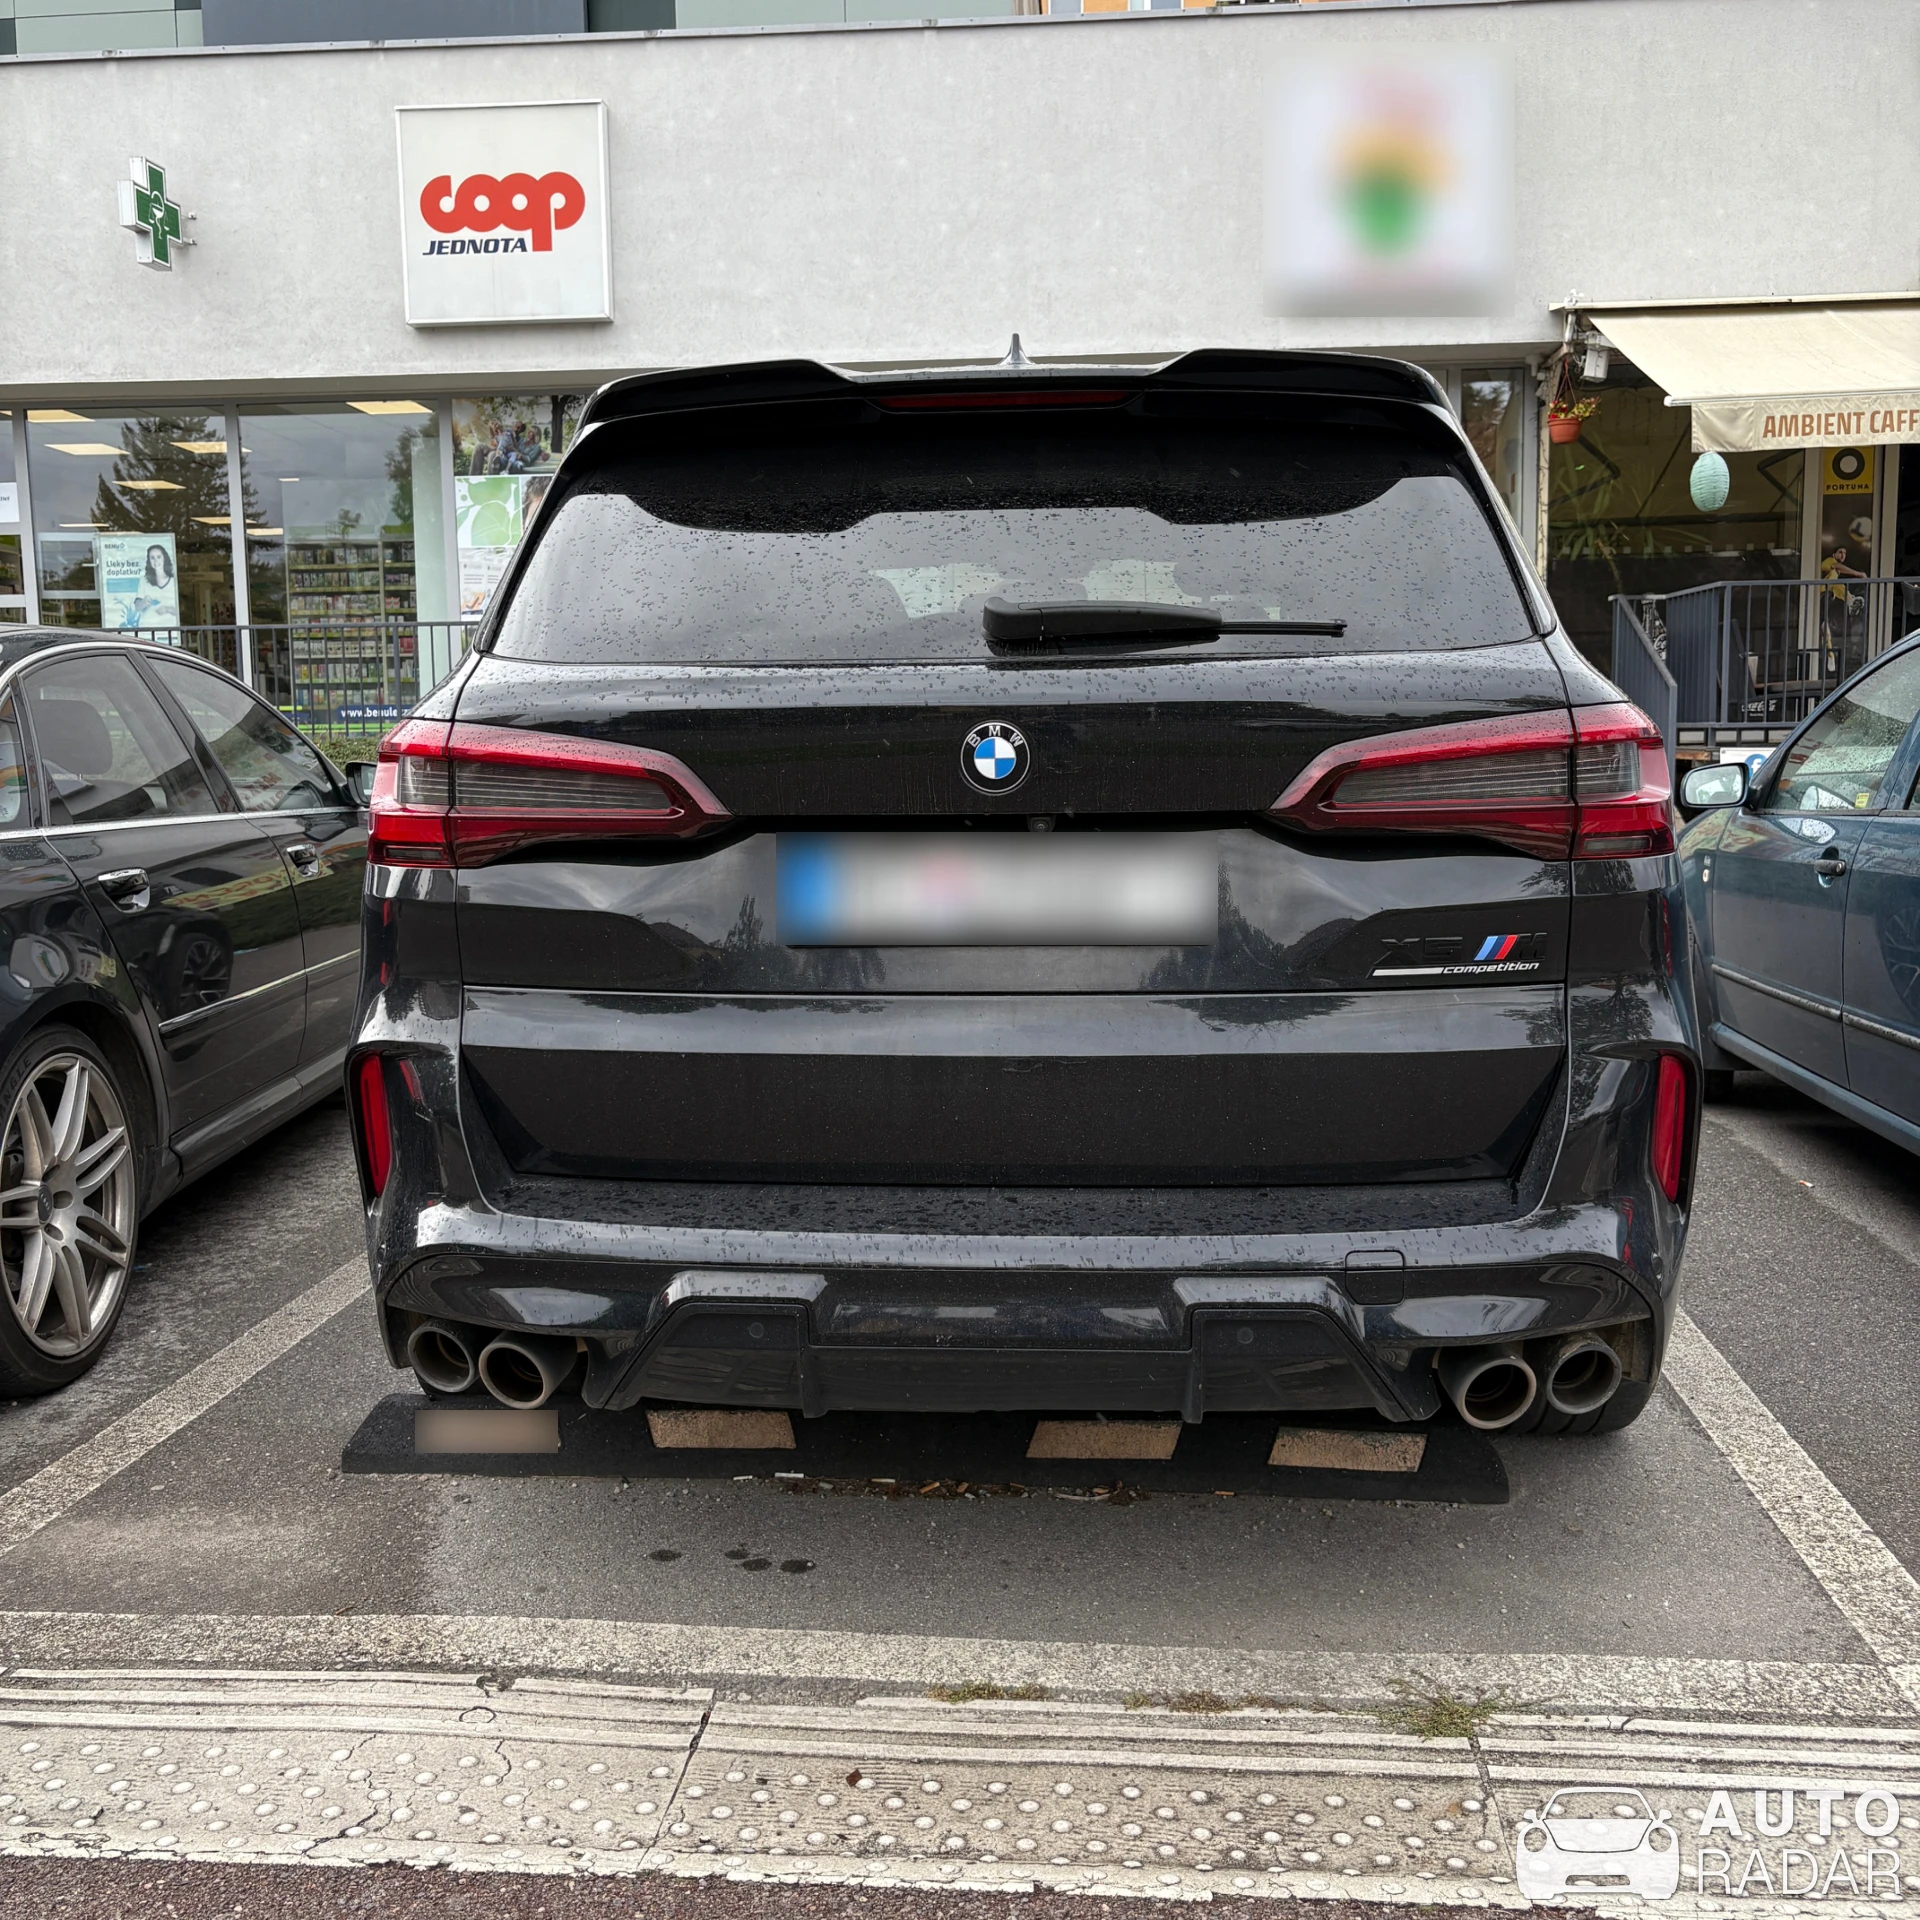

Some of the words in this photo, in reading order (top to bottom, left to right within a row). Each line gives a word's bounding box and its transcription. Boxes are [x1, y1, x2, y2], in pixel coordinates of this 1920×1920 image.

[420, 171, 586, 252] coop
[422, 238, 528, 256] JEDNOTA
[1762, 412, 1865, 438] AMBIENT
[1869, 409, 1920, 434] CAFF
[1826, 483, 1870, 491] FORTUNA
[106, 560, 125, 568] Lieky
[106, 567, 142, 576] doplatku?
[967, 725, 1024, 748] BMW
[1443, 962, 1540, 974] competition
